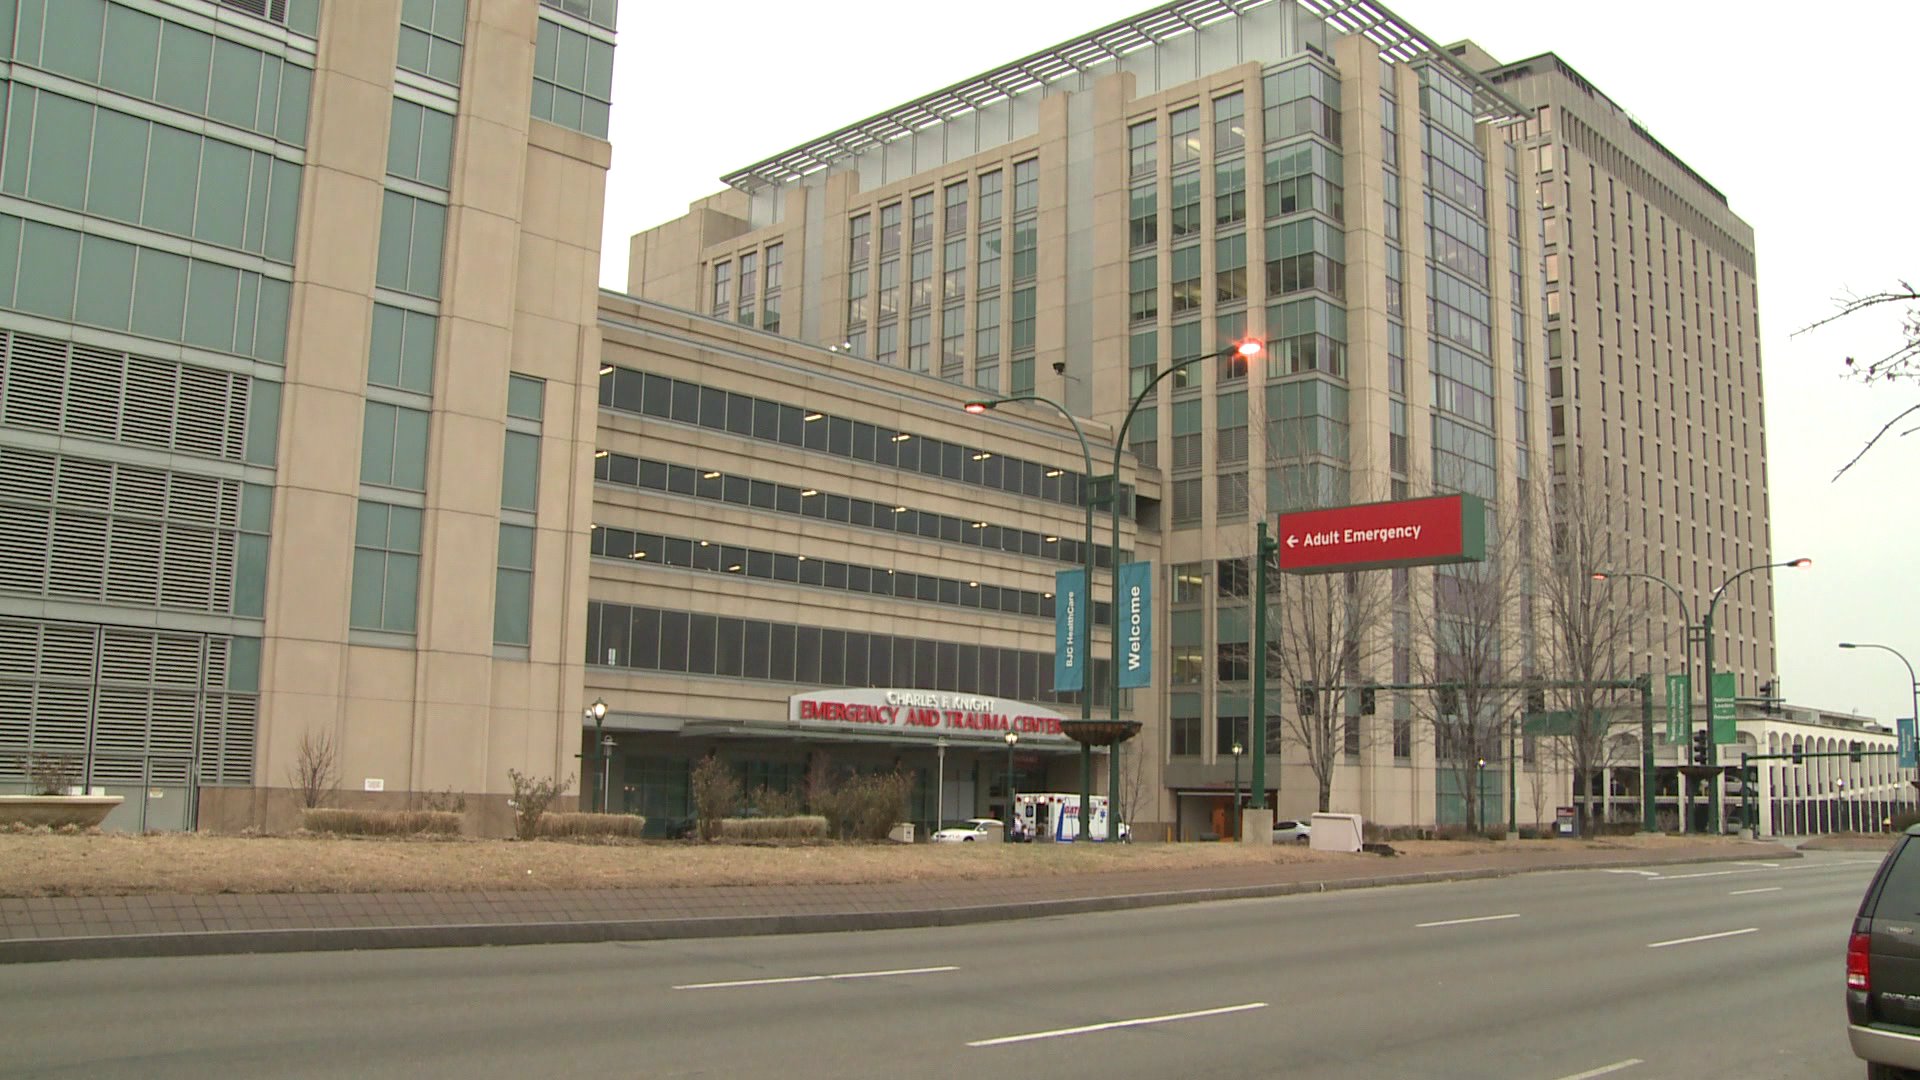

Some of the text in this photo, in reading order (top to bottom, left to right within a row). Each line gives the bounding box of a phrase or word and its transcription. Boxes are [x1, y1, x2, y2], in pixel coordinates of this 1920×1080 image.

[1303, 525, 1422, 547] Adult Emergency
[1128, 586, 1141, 671] Welcome
[886, 690, 995, 711] CHARLES F. KNIGHT
[800, 700, 1061, 734] EMERGENCY AND TRAUMA CENTER
